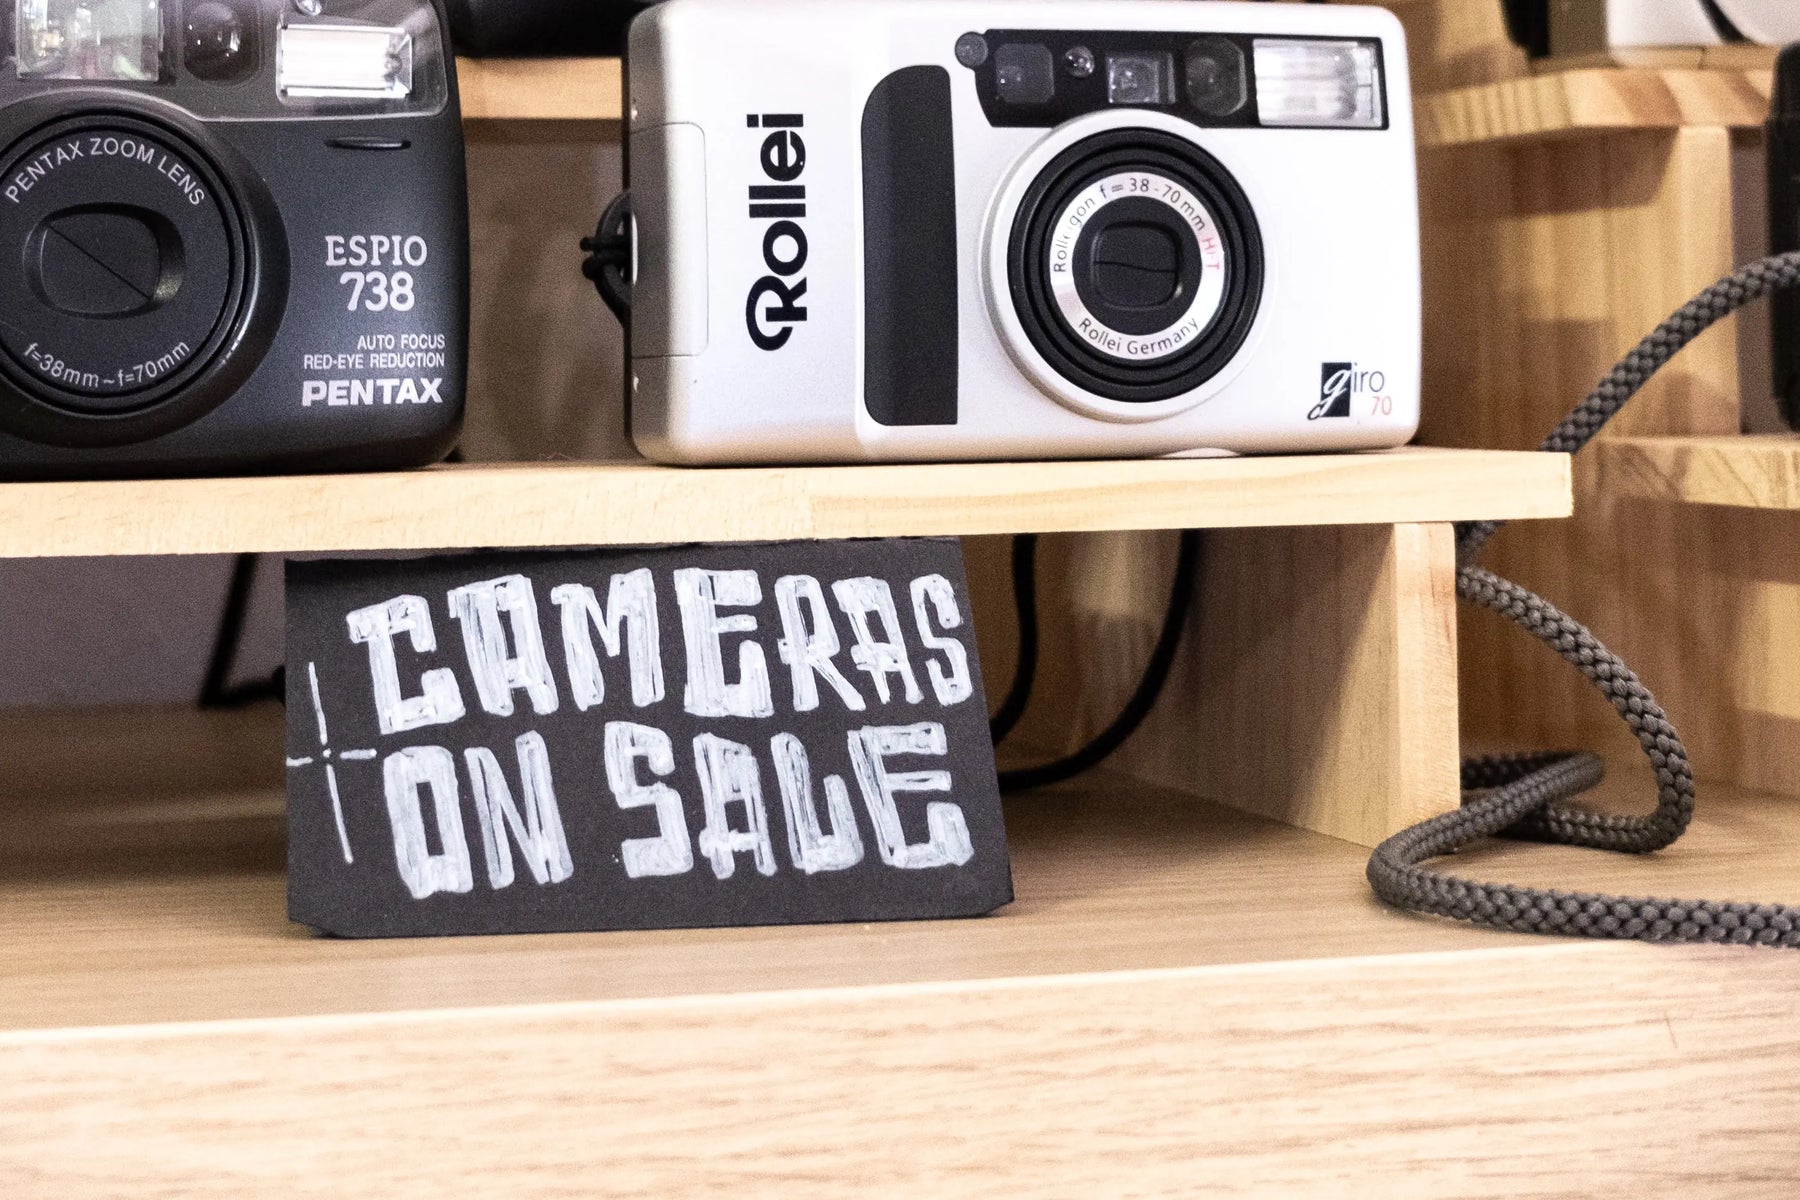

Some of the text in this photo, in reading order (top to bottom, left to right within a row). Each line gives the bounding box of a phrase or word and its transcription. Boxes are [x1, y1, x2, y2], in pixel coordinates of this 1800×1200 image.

[5, 137, 205, 206] PENTAX ZOOM LENS
[325, 235, 428, 267] ESPIO
[746, 113, 808, 351] Rollei
[339, 271, 415, 312] 738
[357, 334, 446, 350] AUTO FOCUS
[1079, 317, 1199, 355] Rollei Germany
[303, 352, 445, 370] RED-EYE REDUCTION
[302, 378, 443, 406] PENTAX
[1372, 395, 1392, 416] 70
[346, 567, 973, 734] CAMERAS
[383, 721, 974, 898] ON SALE
